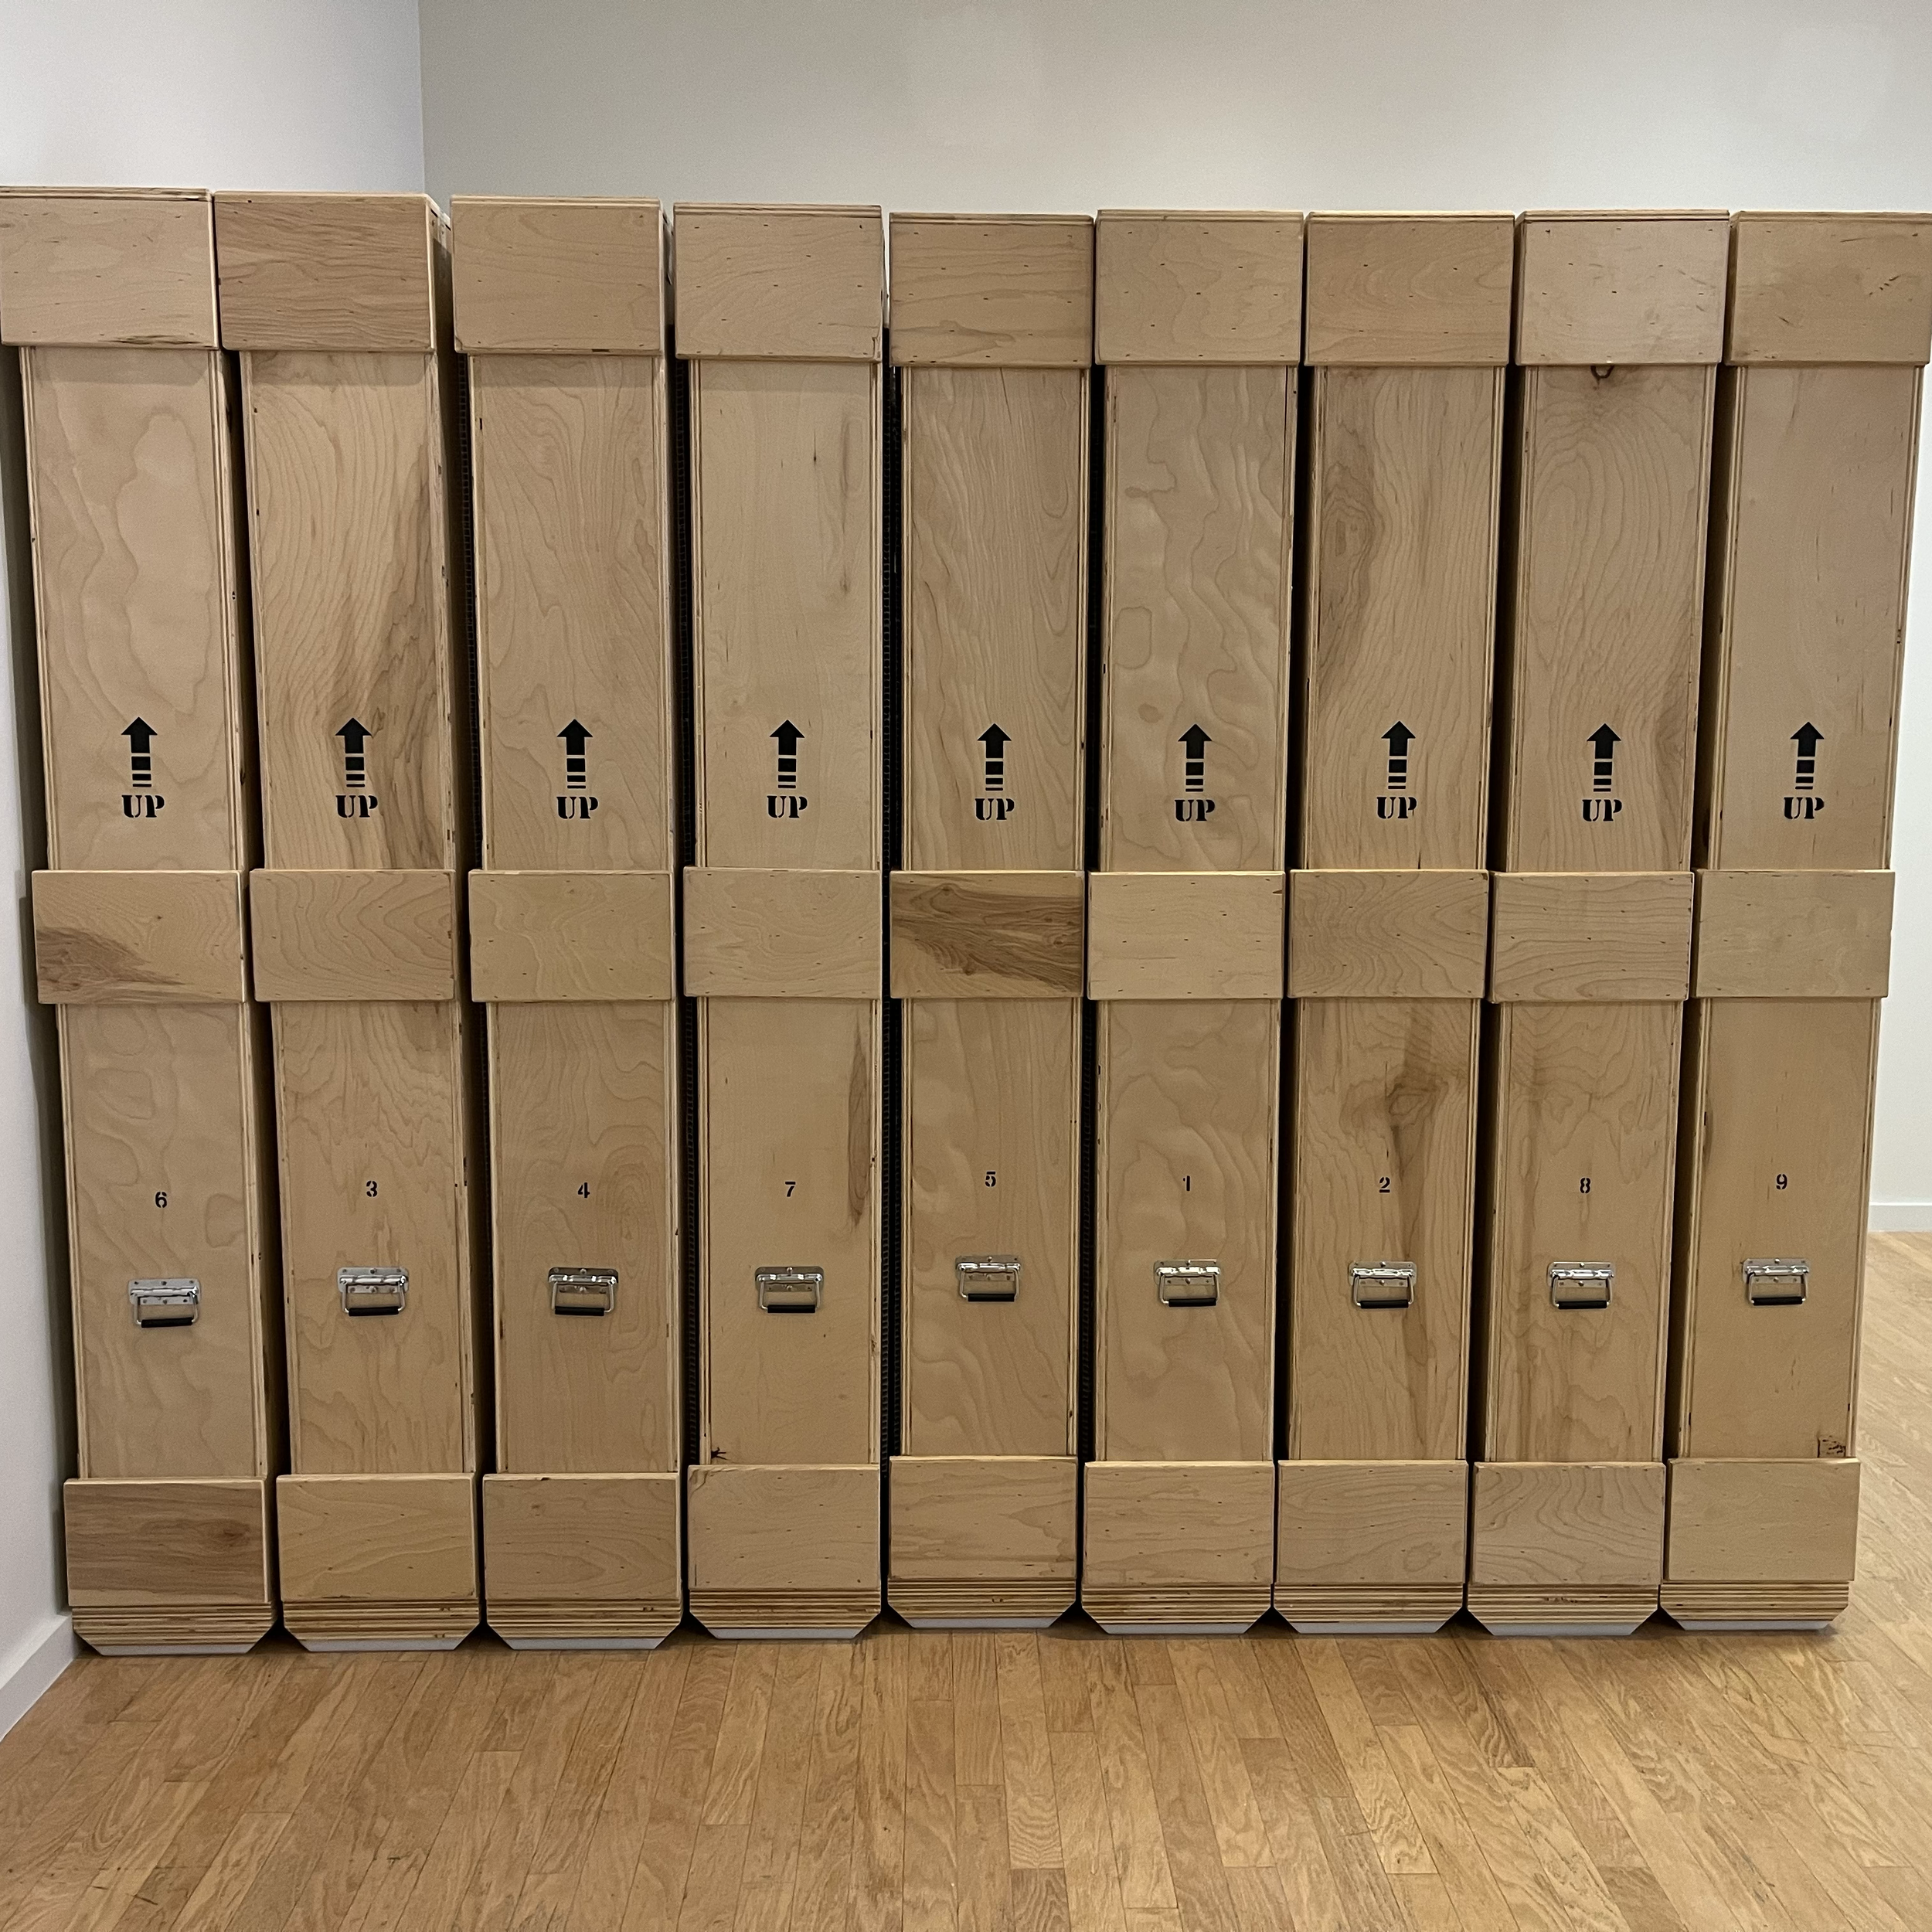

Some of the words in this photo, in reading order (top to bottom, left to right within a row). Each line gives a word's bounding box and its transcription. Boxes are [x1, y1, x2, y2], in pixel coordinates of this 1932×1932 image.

[121, 794, 165, 818] UP
[335, 794, 379, 819] UP
[556, 796, 599, 820] UP
[766, 795, 808, 818] UP
[975, 798, 1015, 821] UP
[1174, 799, 1216, 822] UP
[1376, 796, 1417, 819] UP
[1581, 798, 1623, 822] UP
[1783, 796, 1825, 820] UP
[366, 1180, 378, 1198] 3
[784, 1181, 796, 1198] 7
[985, 1171, 997, 1188] 5
[1182, 1175, 1191, 1192] 1
[1379, 1176, 1391, 1193] 2
[1580, 1177, 1591, 1194] 8
[1776, 1173, 1788, 1190] 9
[155, 1191, 168, 1209] 6
[577, 1182, 590, 1199] 4
